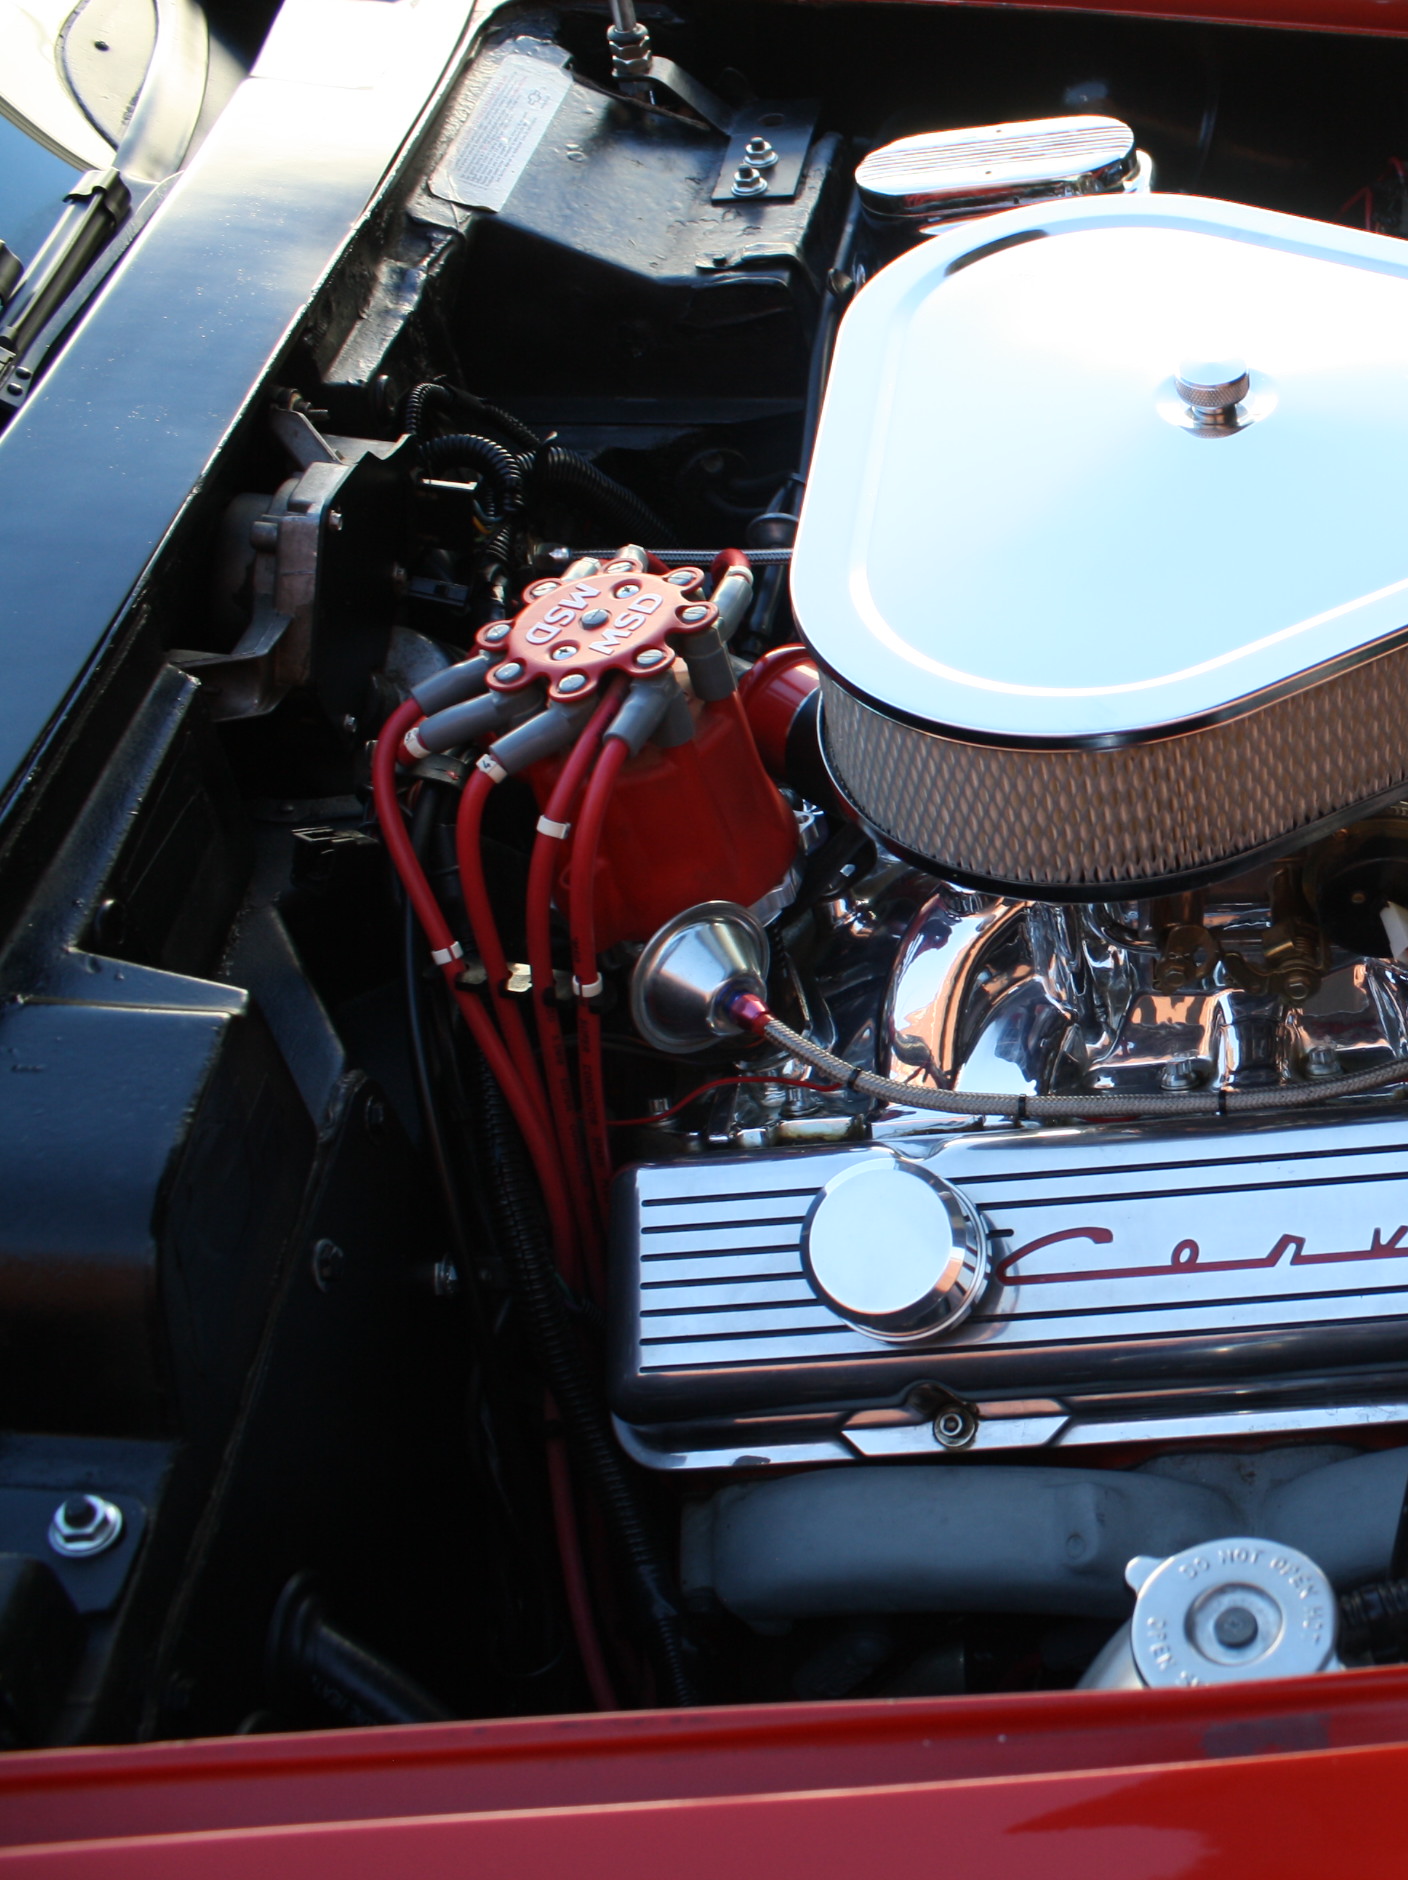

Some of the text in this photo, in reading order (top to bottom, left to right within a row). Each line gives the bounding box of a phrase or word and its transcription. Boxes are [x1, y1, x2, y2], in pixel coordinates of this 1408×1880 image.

[525, 583, 601, 645] MSD
[588, 591, 664, 656] MSD
[1217, 1547, 1267, 1565] NOT
[1269, 1556, 1320, 1600] OPEN
